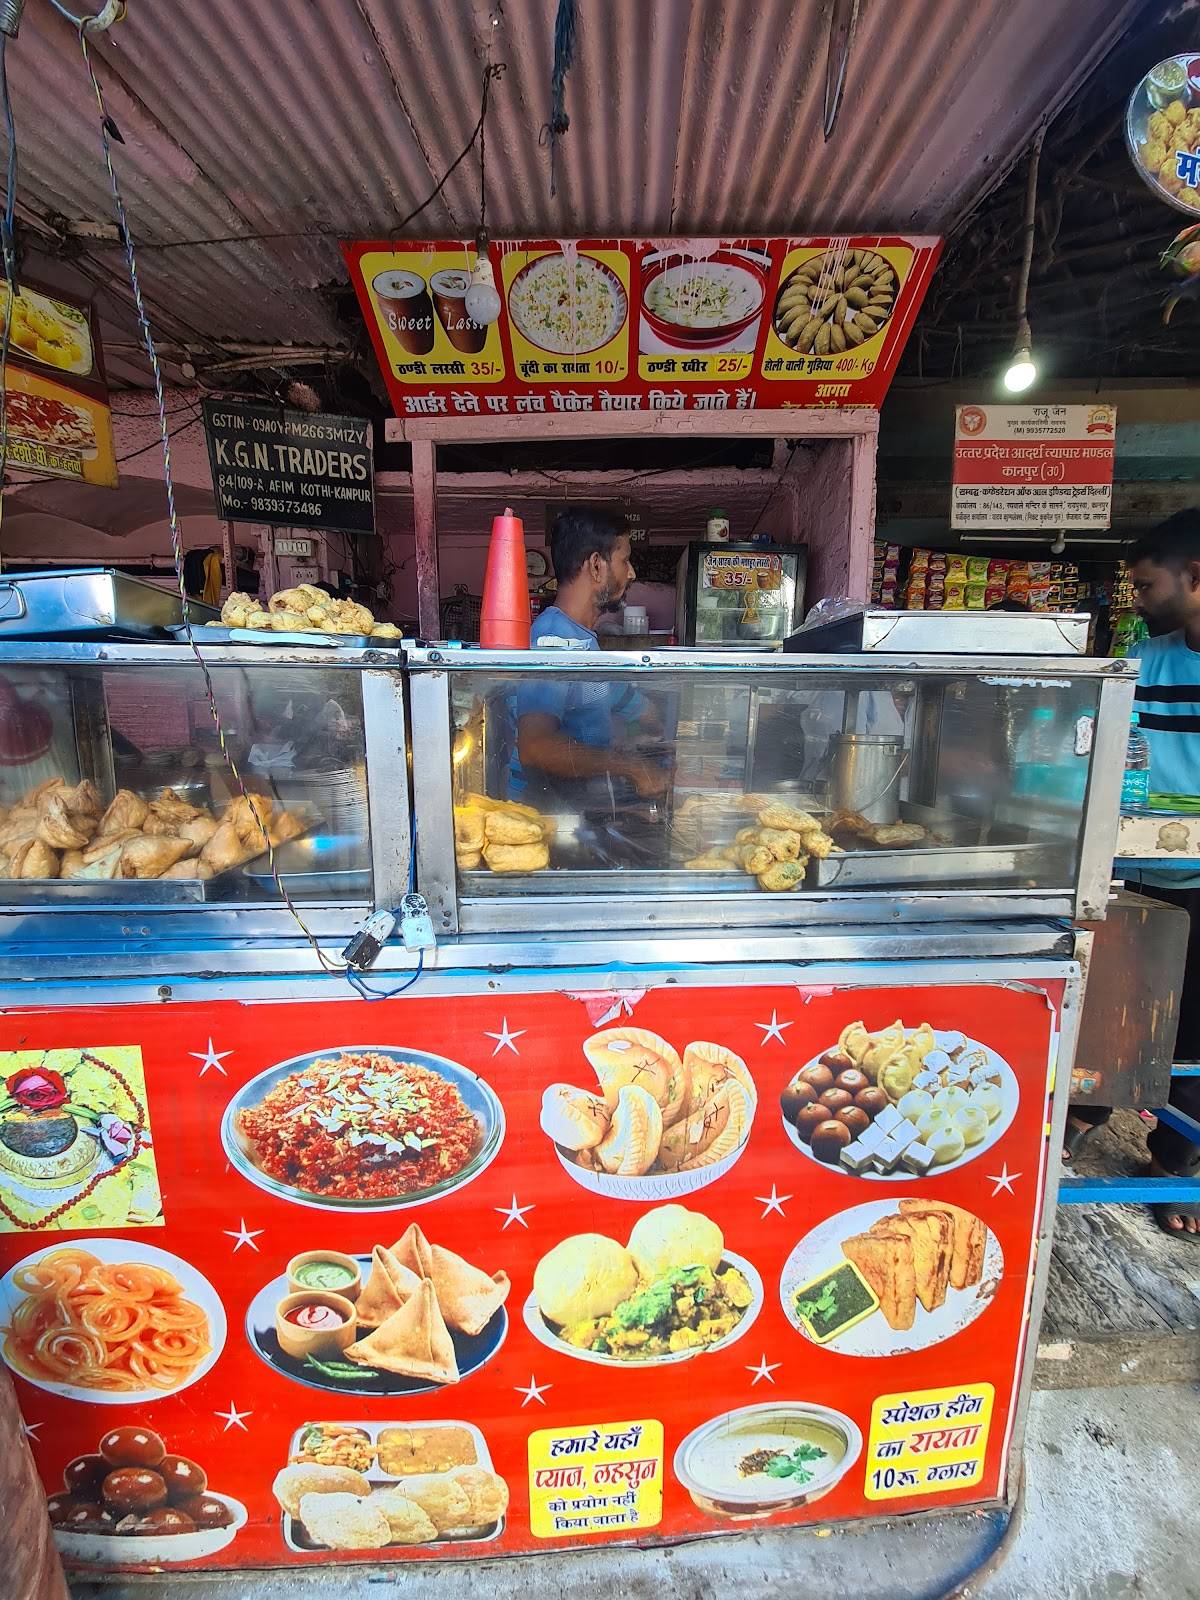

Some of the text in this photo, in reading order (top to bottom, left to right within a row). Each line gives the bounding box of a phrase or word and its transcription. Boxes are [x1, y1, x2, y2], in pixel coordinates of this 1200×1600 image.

[388, 312, 431, 331] Sweet
[396, 361, 501, 375] ठण्डी लस्सी 35/-
[543, 361, 557, 374] का
[595, 360, 625, 374] 10/-
[647, 357, 748, 373] ठण्डी खीर 25/-
[764, 357, 782, 371] होली
[785, 356, 804, 371] वाली
[807, 357, 834, 374] गुझिया
[860, 358, 875, 374] Kg
[815, 383, 852, 398] आगरा
[403, 390, 447, 413] आर्डर
[450, 391, 480, 413] देने
[484, 395, 509, 412] पर
[513, 390, 545, 412] लंच
[550, 389, 593, 412] पैकेट
[599, 389, 642, 411] तैयार
[648, 389, 687, 411] किये
[693, 389, 731, 410] जाते
[1033, 407, 1050, 419] राजू
[1013, 427, 1025, 435] (M)
[955, 443, 1114, 460] उत्तर प्रदेश आदर्श व्यापार मण्डल
[274, 444, 367, 481] TRADERS
[1002, 466, 1039, 481] कानपुर
[269, 479, 295, 495] AFIM
[300, 483, 372, 503] KOTHI-KANPUR
[882, 1393, 984, 1425] स्पेशल हींग
[551, 1426, 642, 1457] हमारे यहाँ
[877, 1424, 983, 1458] का रायता
[536, 1458, 658, 1489] प्याज, लहसुन
[927, 1460, 979, 1482] ग्लास
[572, 1495, 608, 1510] प्रयोग
[612, 1491, 637, 1506] नहीं
[555, 1508, 639, 1530] किया जाता है
